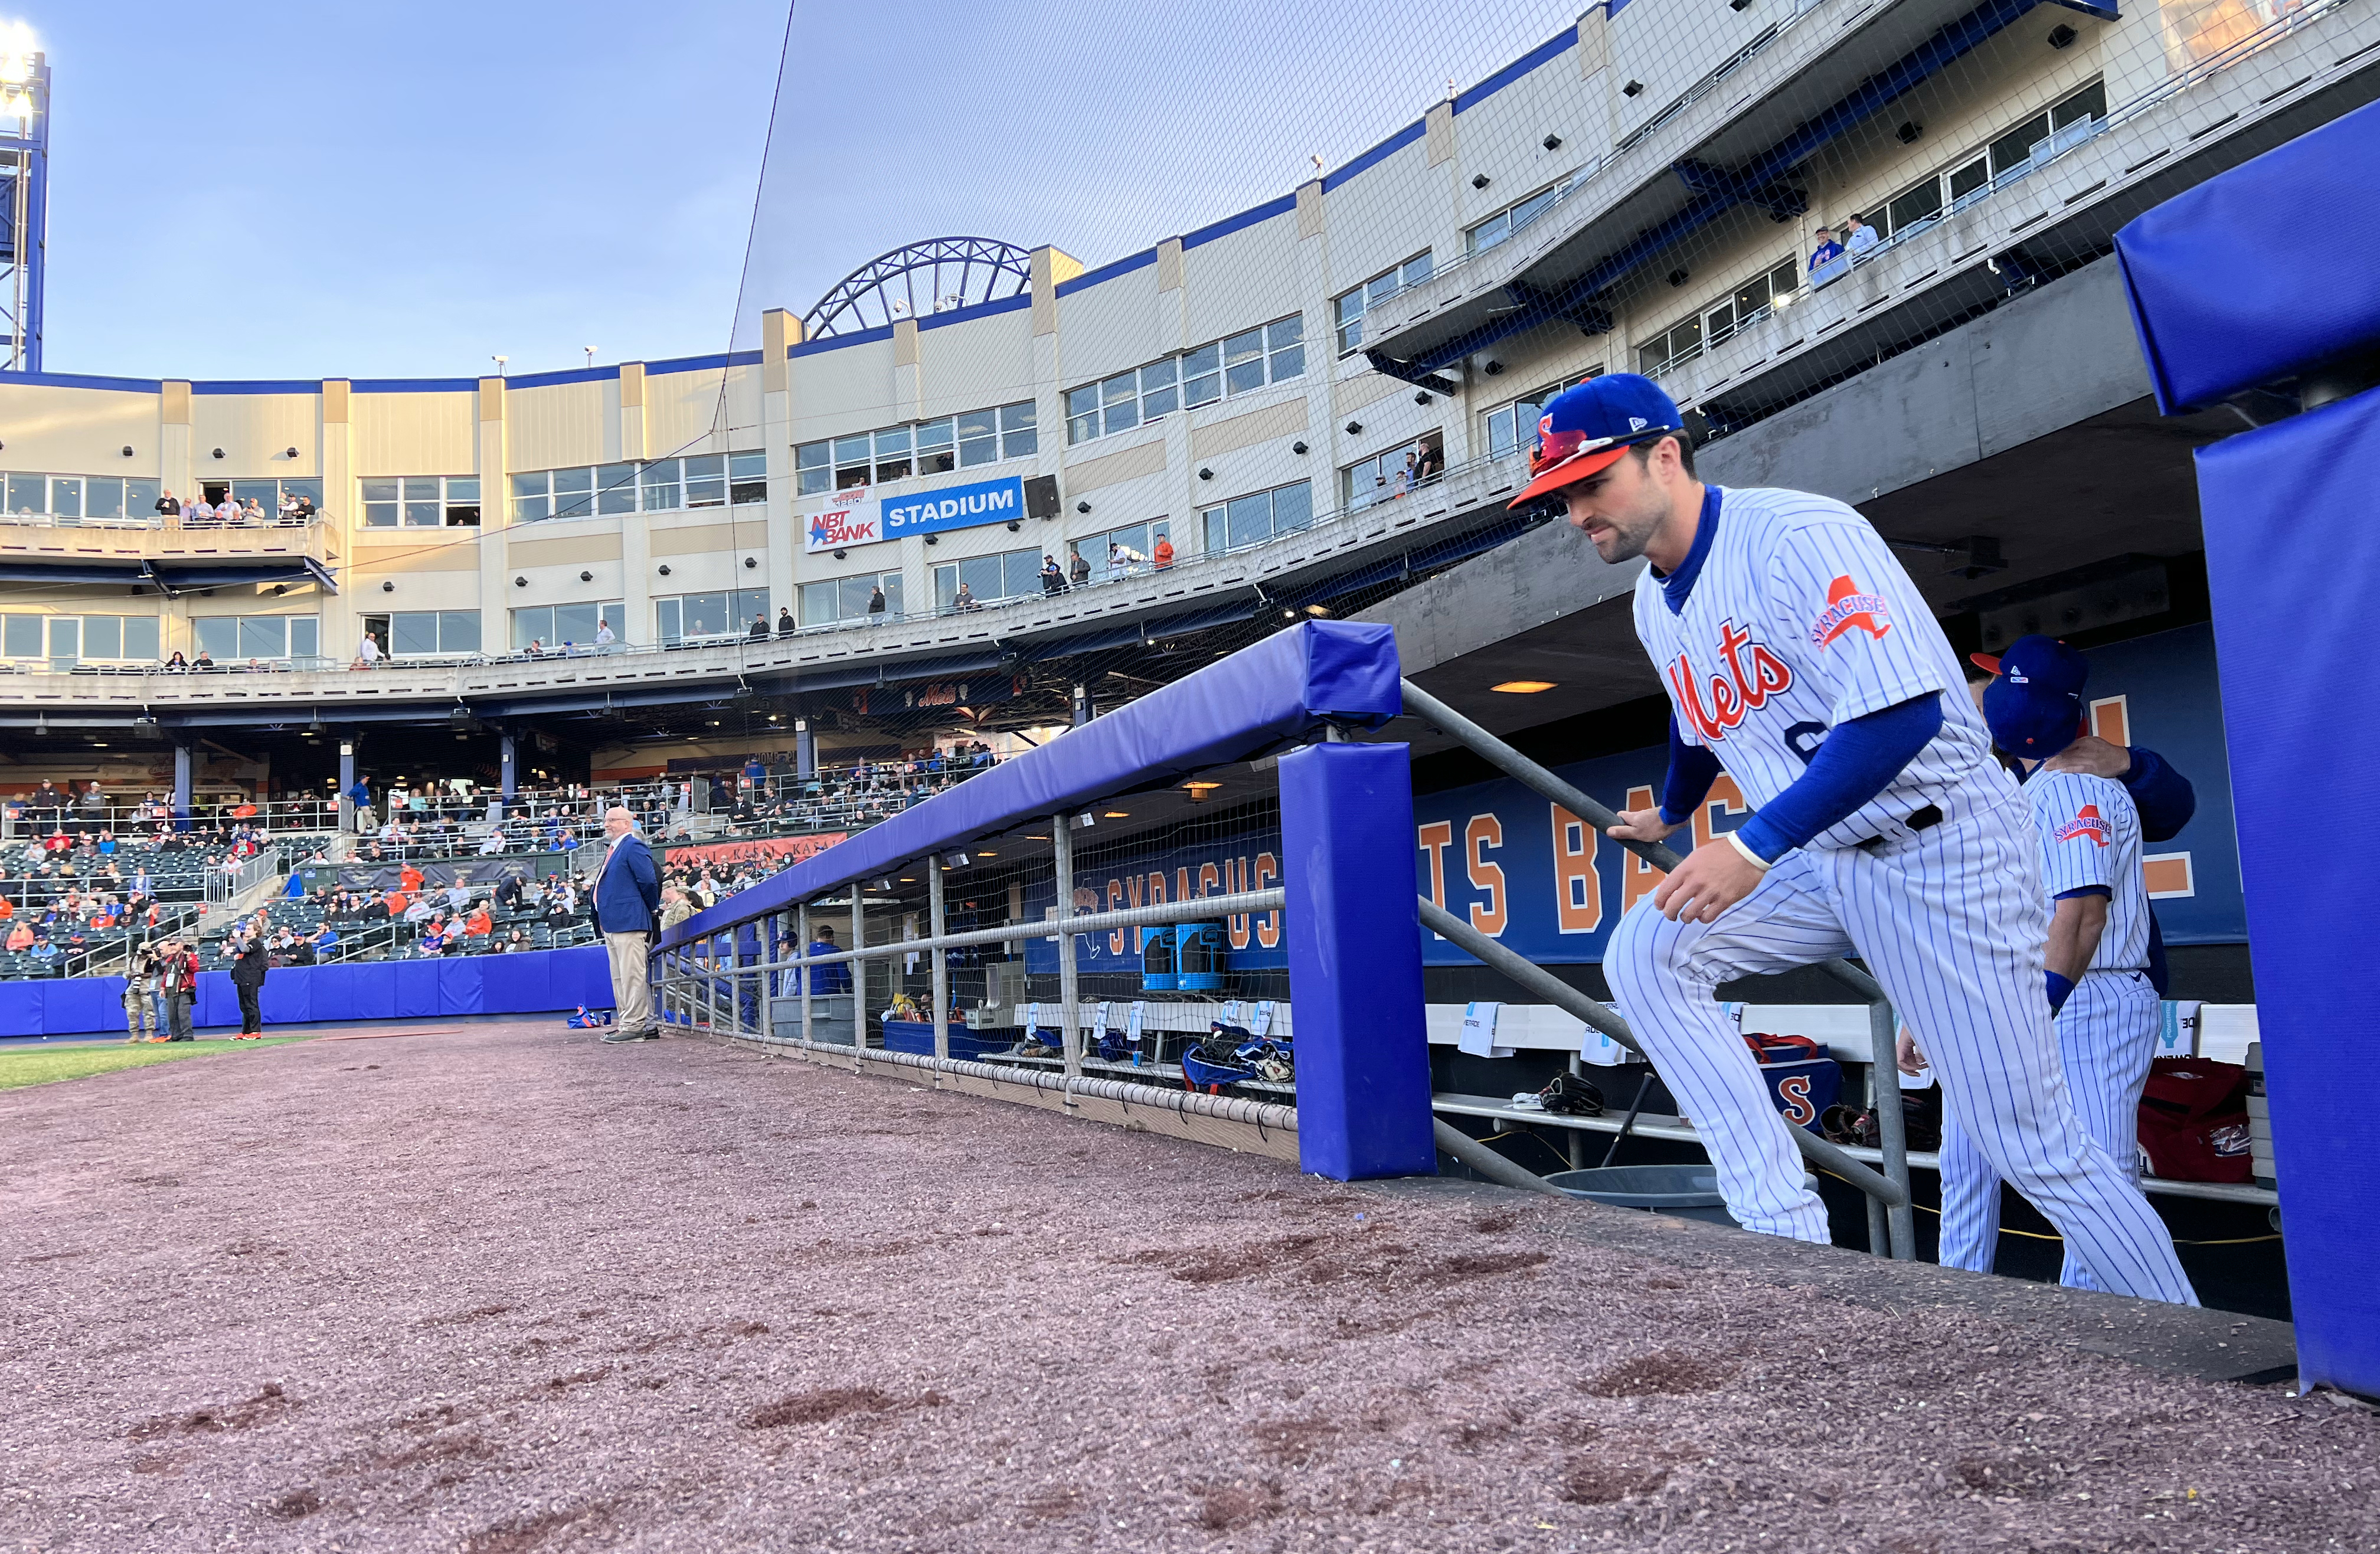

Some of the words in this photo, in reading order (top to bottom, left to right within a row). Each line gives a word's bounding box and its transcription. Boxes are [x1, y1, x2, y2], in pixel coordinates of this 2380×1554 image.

[812, 510, 850, 530] NBT
[888, 489, 1014, 527] STADIUM
[822, 522, 875, 545] BANK
[1810, 596, 1884, 649] SYRACUSE
[918, 684, 957, 707] Mets
[1666, 617, 1794, 751] Mets
[2054, 817, 2111, 842] SYRACUSE
[676, 851, 716, 865] KASAI
[1778, 1075, 1816, 1127] S
